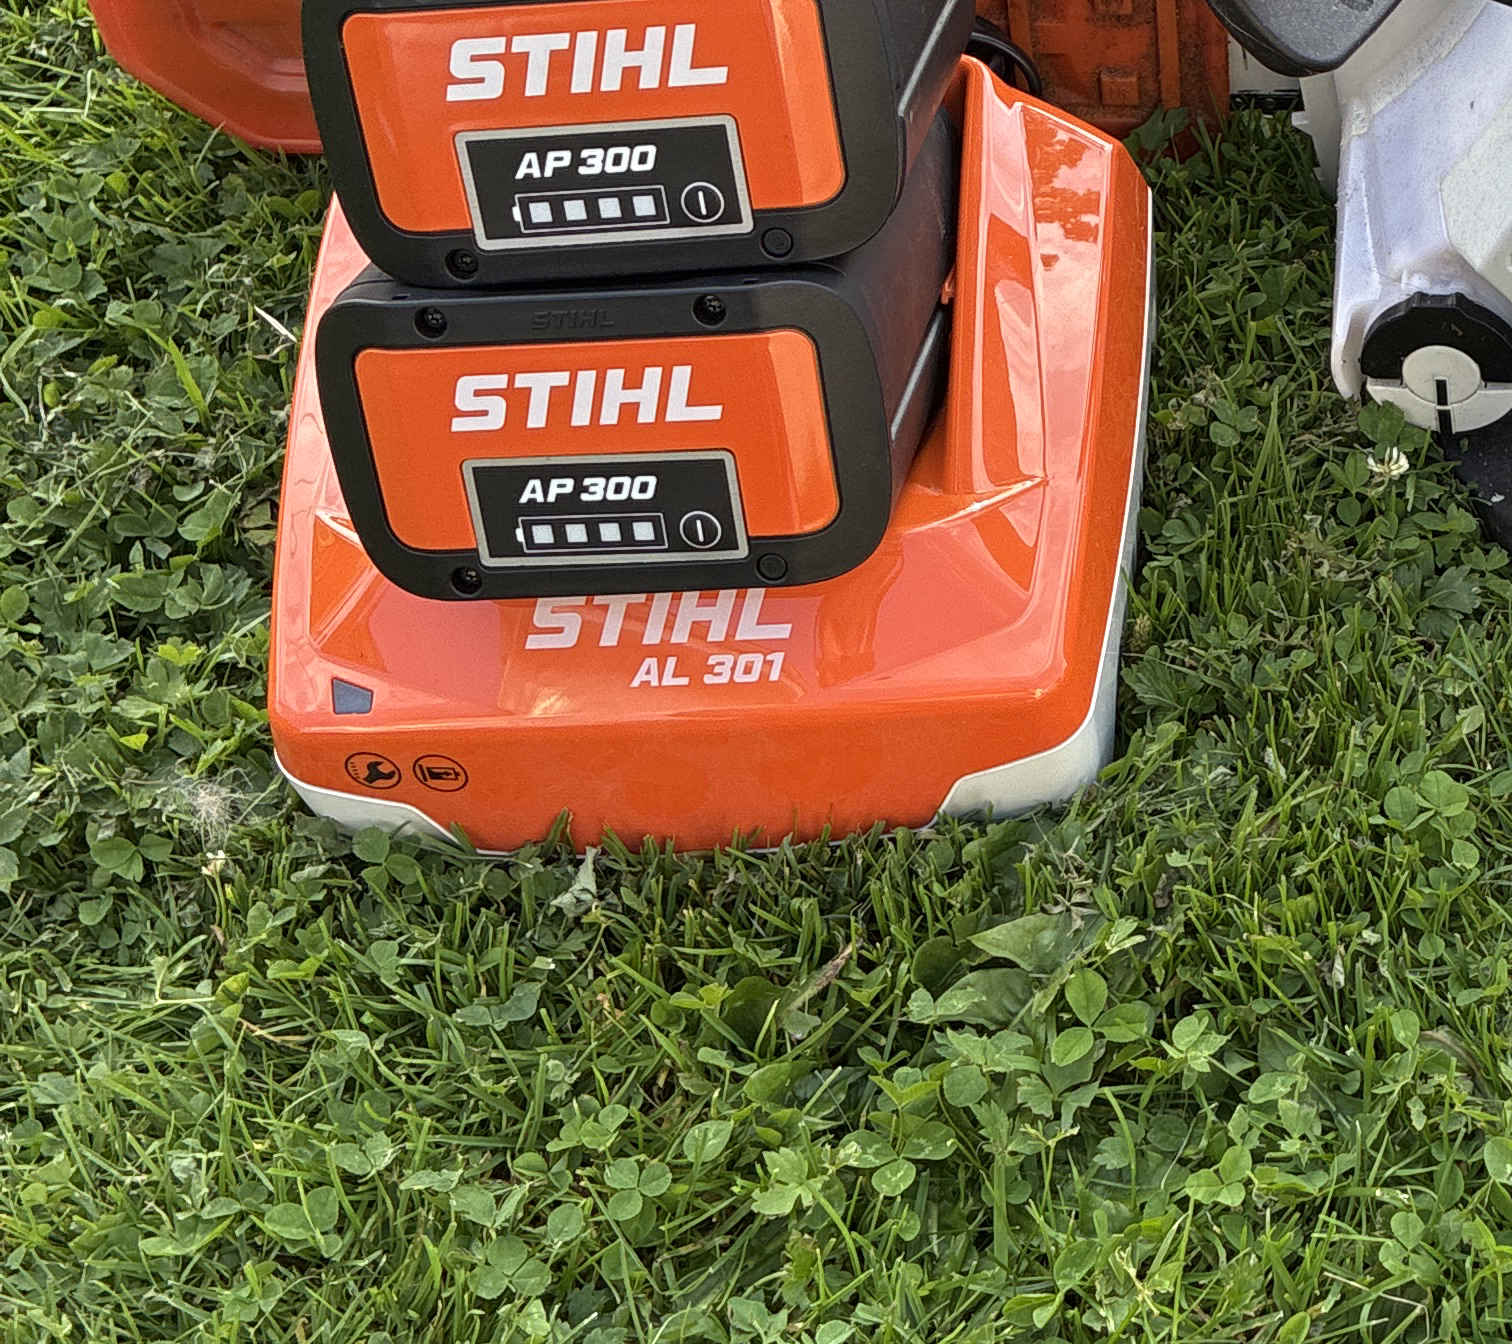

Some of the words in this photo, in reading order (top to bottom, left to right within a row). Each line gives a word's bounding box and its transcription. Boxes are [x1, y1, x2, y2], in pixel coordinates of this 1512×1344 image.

[446, 23, 728, 102] STIHL
[515, 150, 572, 179] AP
[578, 145, 657, 175] 300
[532, 309, 616, 331] STIHL
[450, 365, 723, 432] STIHL
[519, 478, 574, 503] AP
[580, 475, 657, 501] 300
[524, 588, 792, 650] STIHL
[629, 657, 690, 687] AL
[703, 652, 785, 684] 301
